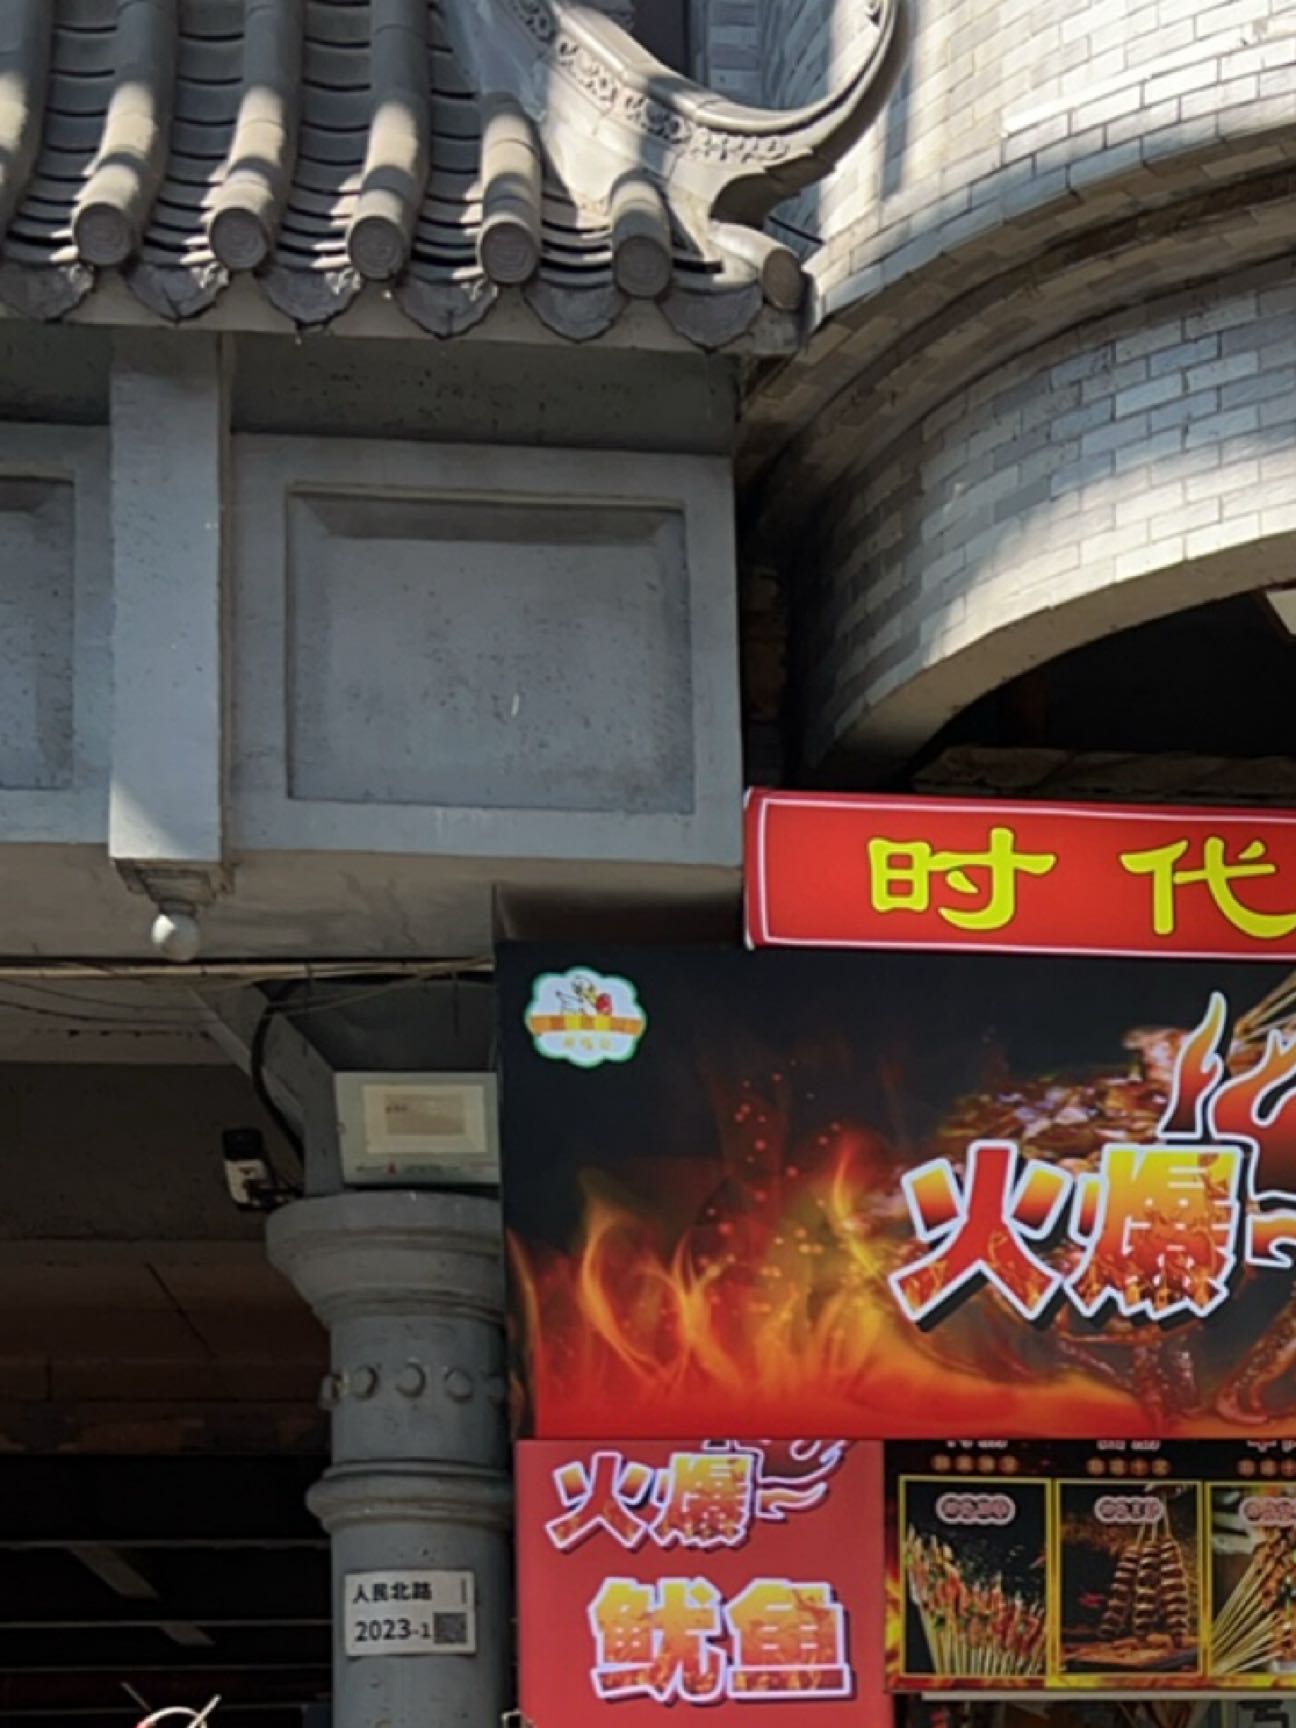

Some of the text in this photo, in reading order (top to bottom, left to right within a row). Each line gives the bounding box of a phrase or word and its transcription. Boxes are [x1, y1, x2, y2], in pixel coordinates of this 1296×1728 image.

[546, 1451, 754, 1548] 火爆
[353, 1581, 433, 1604] 人民北路
[354, 1618, 432, 1642] 2023-1
[588, 1577, 851, 1701] 鱿鱼
